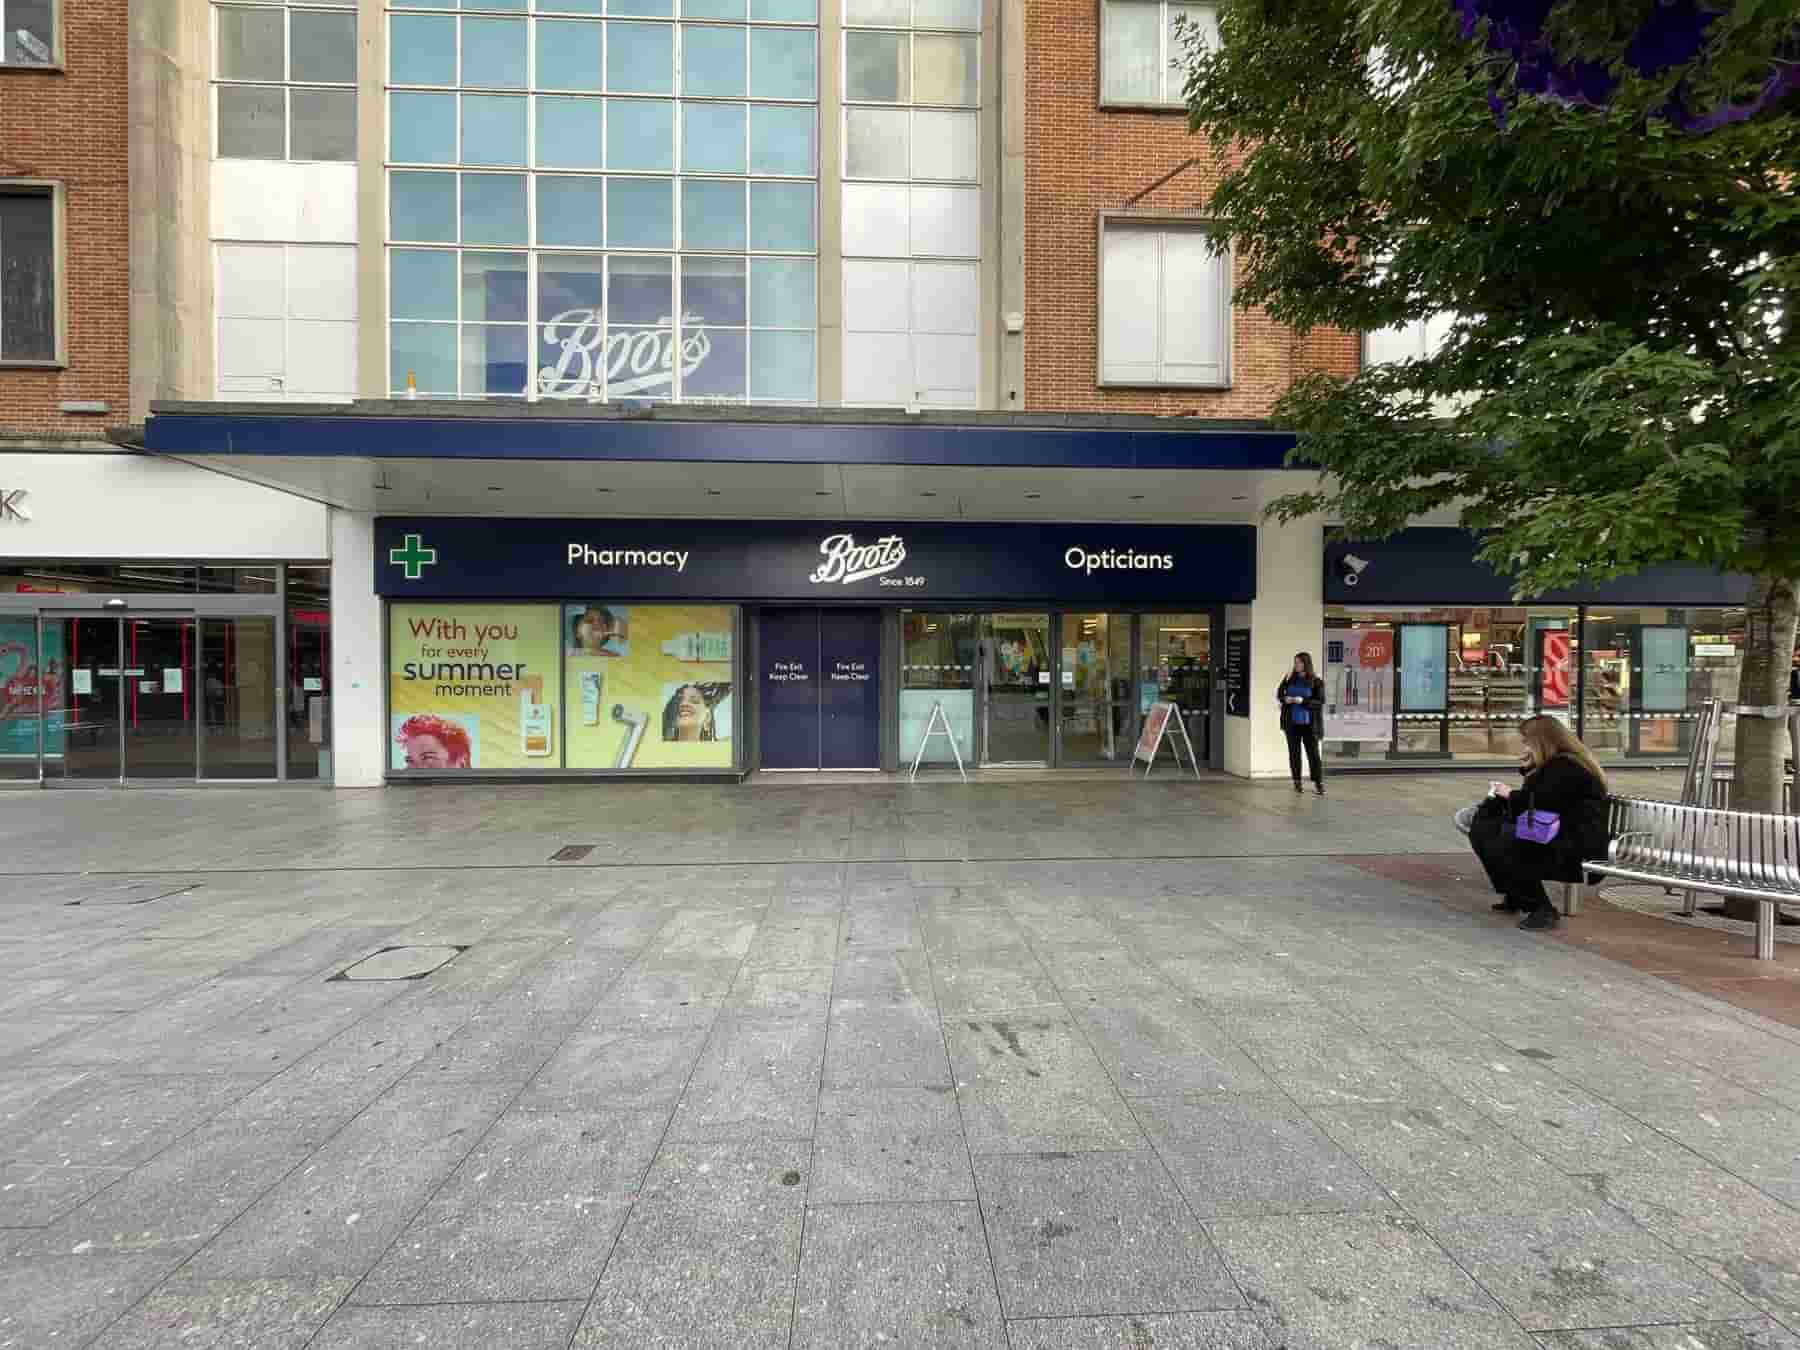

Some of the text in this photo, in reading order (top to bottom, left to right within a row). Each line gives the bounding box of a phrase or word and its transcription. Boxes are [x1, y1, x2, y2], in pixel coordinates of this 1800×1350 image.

[523, 307, 712, 402] Boots
[567, 543, 689, 572] Pharmacy
[809, 533, 907, 585] Boots
[1064, 547, 1174, 575] Opticians
[880, 576, 902, 586] Since
[408, 618, 519, 646] With you
[421, 643, 490, 662] for every
[403, 661, 527, 682] summer
[769, 672, 809, 683] Keep Clear
[435, 683, 513, 697] moment
